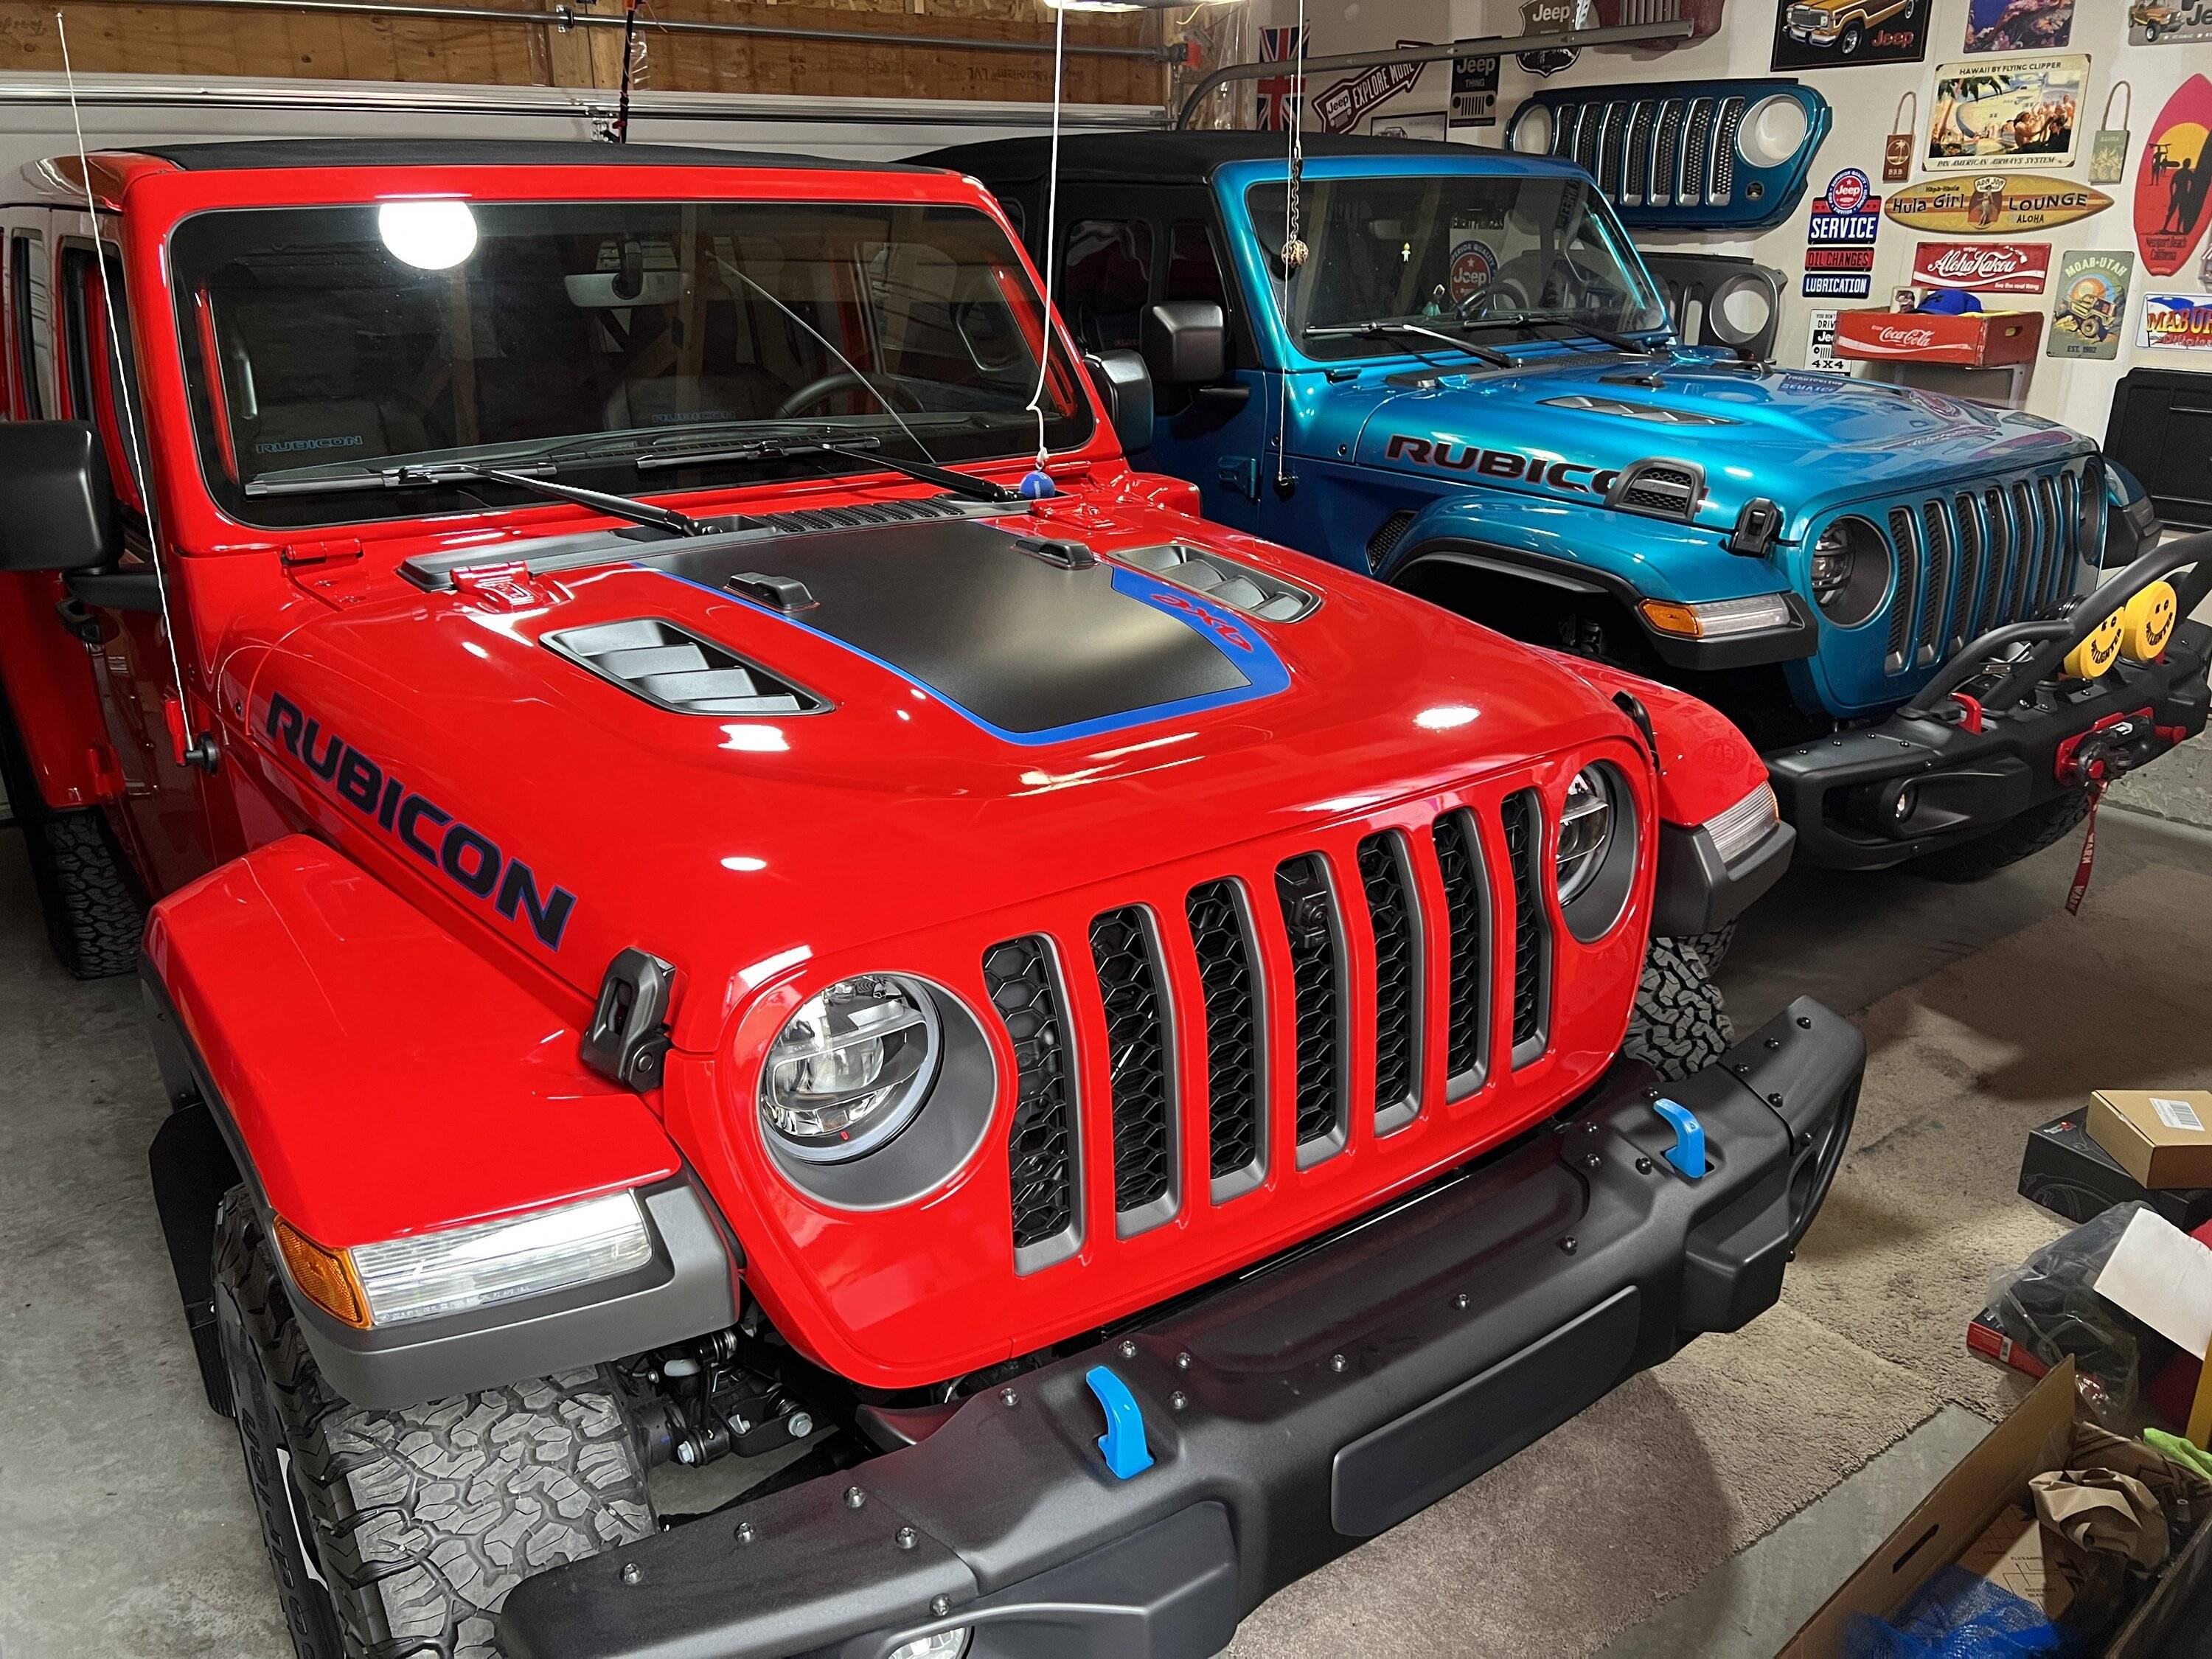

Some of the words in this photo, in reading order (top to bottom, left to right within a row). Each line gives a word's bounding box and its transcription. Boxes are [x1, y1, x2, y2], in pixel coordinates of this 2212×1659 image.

[1532, 4, 1571, 23] Jeep
[2186, 4, 2212, 26] Je
[1871, 29, 1915, 48] Jeep
[1455, 57, 1496, 76] Jeep
[1959, 66, 1990, 74] HAWAII
[2028, 62, 2062, 70] CLIPPER
[1352, 68, 1390, 109] EXPLORE
[1465, 78, 1485, 88] THING
[1327, 95, 1349, 115] Jeep
[1937, 159, 1950, 167] PAN
[1951, 158, 1989, 167] AMERICAN
[1990, 157, 2024, 166] AIRWAYS
[2024, 156, 2056, 164] SYSTEM
[1835, 184, 1860, 197] Jeep
[1892, 198, 1927, 214] Hula
[1933, 193, 1965, 209] Girl
[2008, 192, 2088, 212] LOUNGE
[1810, 217, 1877, 239] SERVICE
[2016, 214, 2045, 223] ALOHA
[1808, 253, 1824, 267] OIL
[1826, 252, 1870, 267] CHANGES
[1453, 267, 1488, 286] Jeep
[1805, 278, 1868, 293] LUBRICATION
[2067, 345, 2080, 353] EST.
[1812, 359, 1844, 369] 4X4
[256, 435, 364, 454] RUBICON
[265, 689, 578, 953] RUBICON
[2081, 832, 2095, 865] WARN
